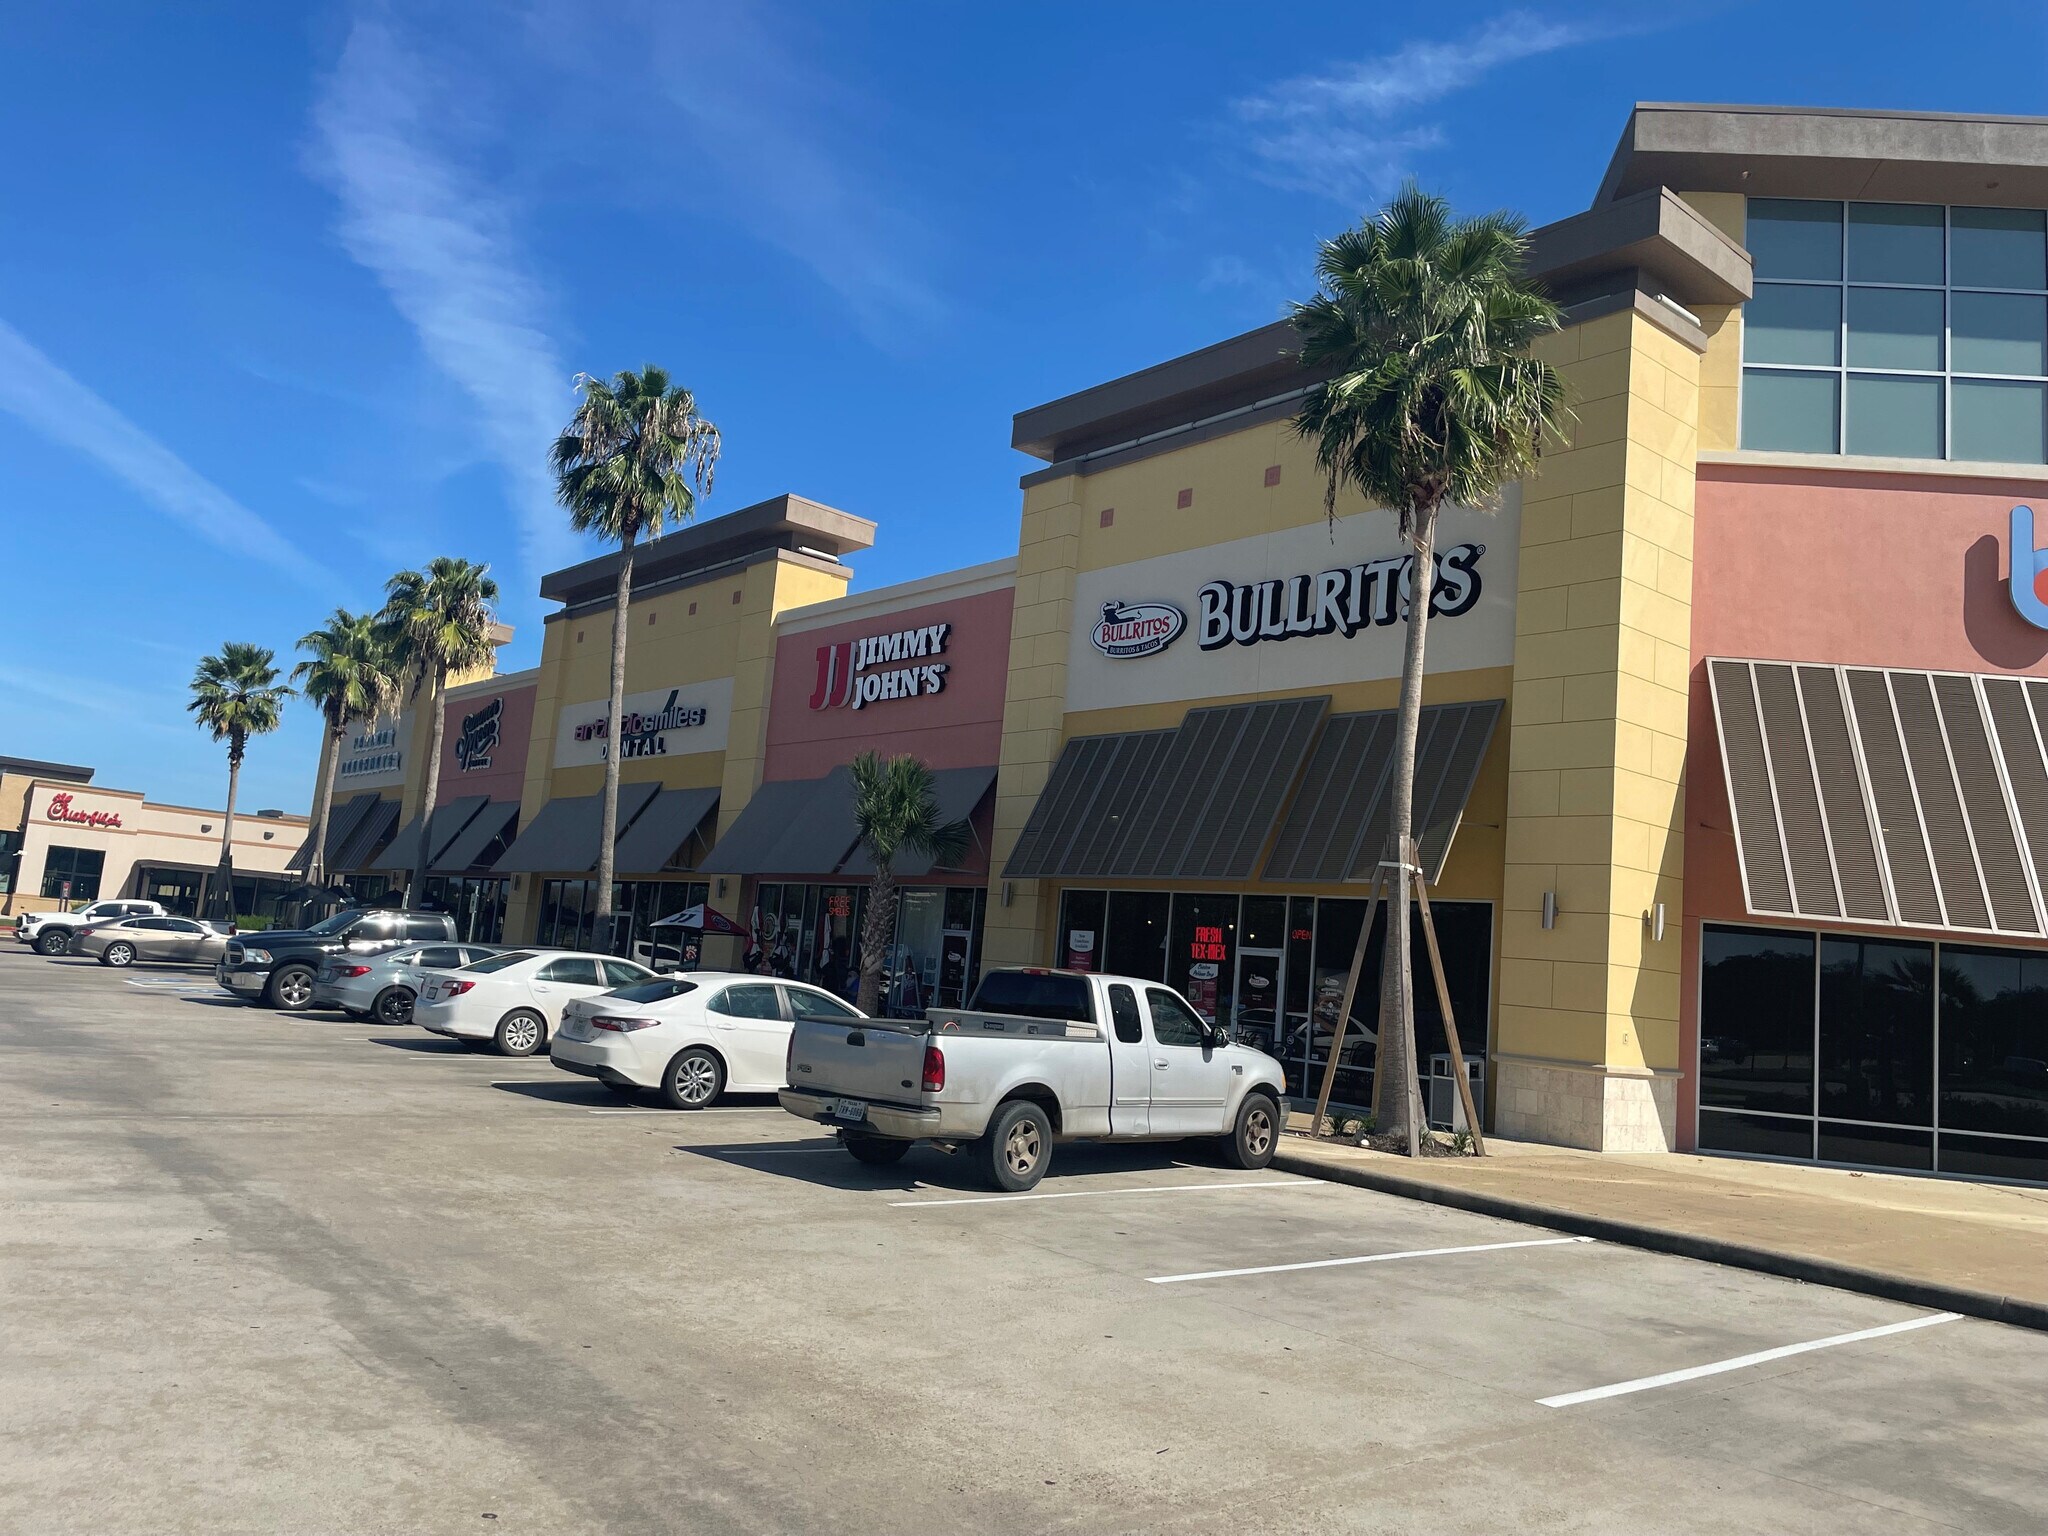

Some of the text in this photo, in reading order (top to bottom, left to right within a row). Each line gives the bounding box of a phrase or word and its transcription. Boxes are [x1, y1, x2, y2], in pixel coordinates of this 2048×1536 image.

[1101, 616, 1170, 643] BULLRITOS
[856, 623, 948, 671] JIMMY
[1109, 645, 1136, 654] BURRITOS
[1140, 640, 1158, 651] TACOS
[809, 641, 855, 711] JJ
[852, 663, 942, 710] JOHN'S
[574, 706, 704, 741] artiticsmiles
[600, 736, 664, 760] DNTAL
[828, 895, 851, 908] FREE
[1195, 926, 1222, 943] FRESH
[1291, 929, 1312, 941] OPEN
[1191, 943, 1226, 960] TEX-MEX
